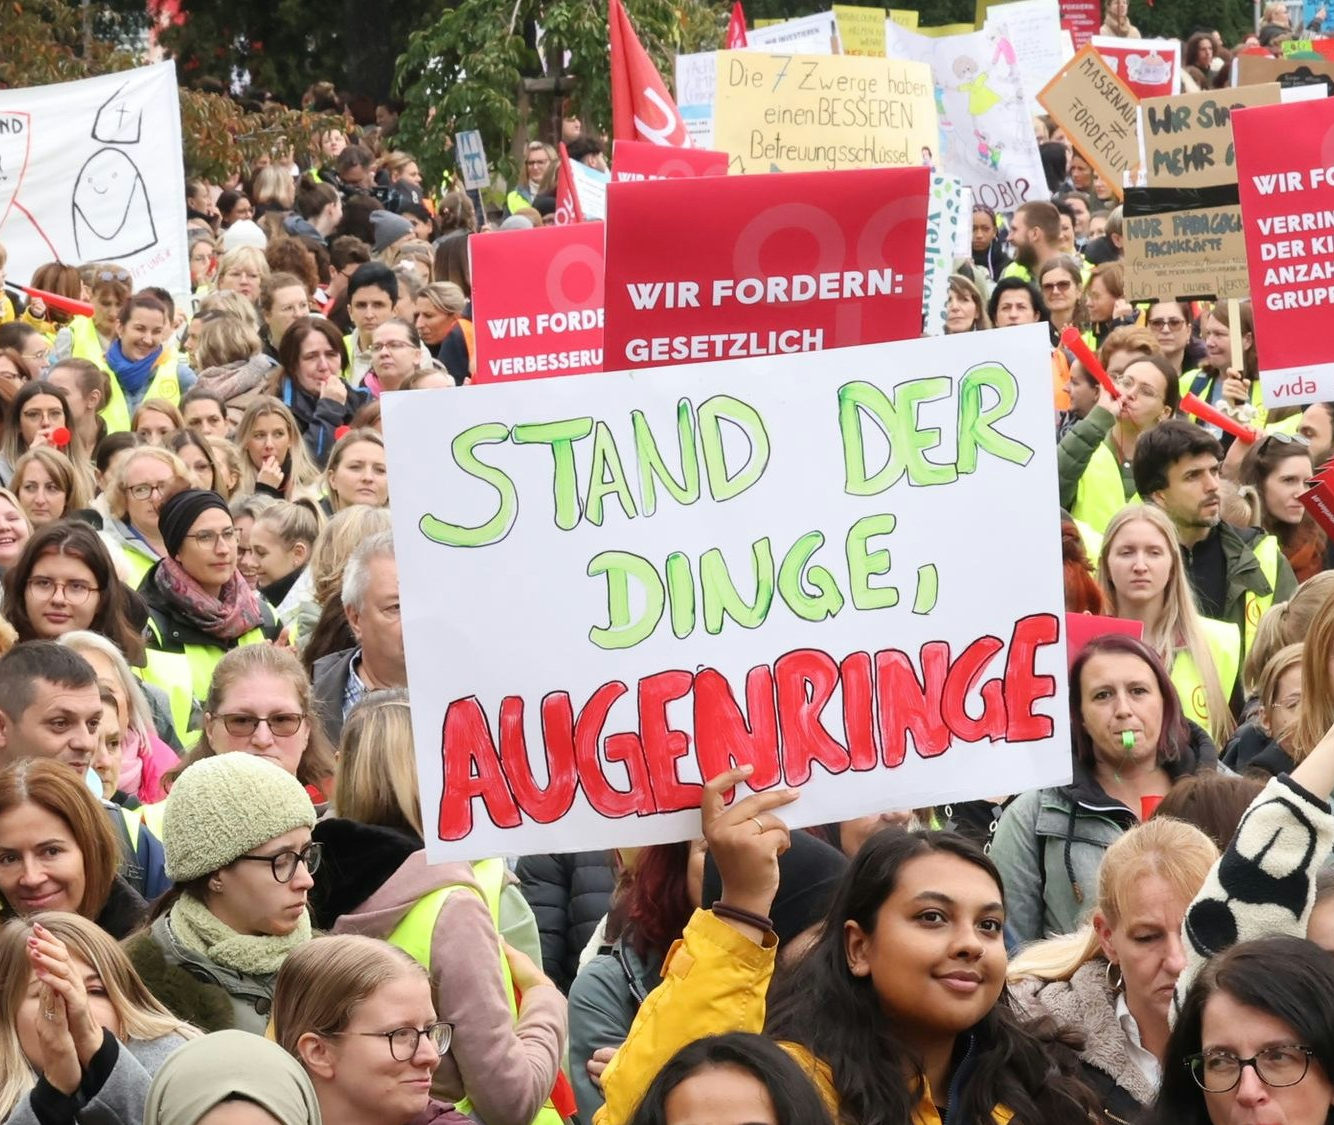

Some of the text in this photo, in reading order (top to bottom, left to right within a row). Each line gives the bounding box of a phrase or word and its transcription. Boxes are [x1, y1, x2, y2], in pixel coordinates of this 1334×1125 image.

[729, 59, 764, 87] Die
[771, 55, 793, 93] 7
[798, 62, 877, 98] Zwerge
[888, 67, 928, 98] haben
[764, 98, 914, 129] einen BESSEREN
[1148, 105, 1191, 136] WIR
[1153, 142, 1216, 177] MEHR
[1252, 171, 1304, 196] WIR
[1128, 217, 1163, 241] NUR
[1260, 238, 1307, 261] DER
[626, 267, 904, 310] WIR FORDERN:
[487, 315, 530, 339] WIR
[624, 328, 824, 362] GESETZLICH
[1273, 375, 1317, 398] vida
[419, 361, 1036, 547] STAND DER
[586, 513, 939, 650] DINGE,
[438, 612, 1060, 842] AUGENRINGE
